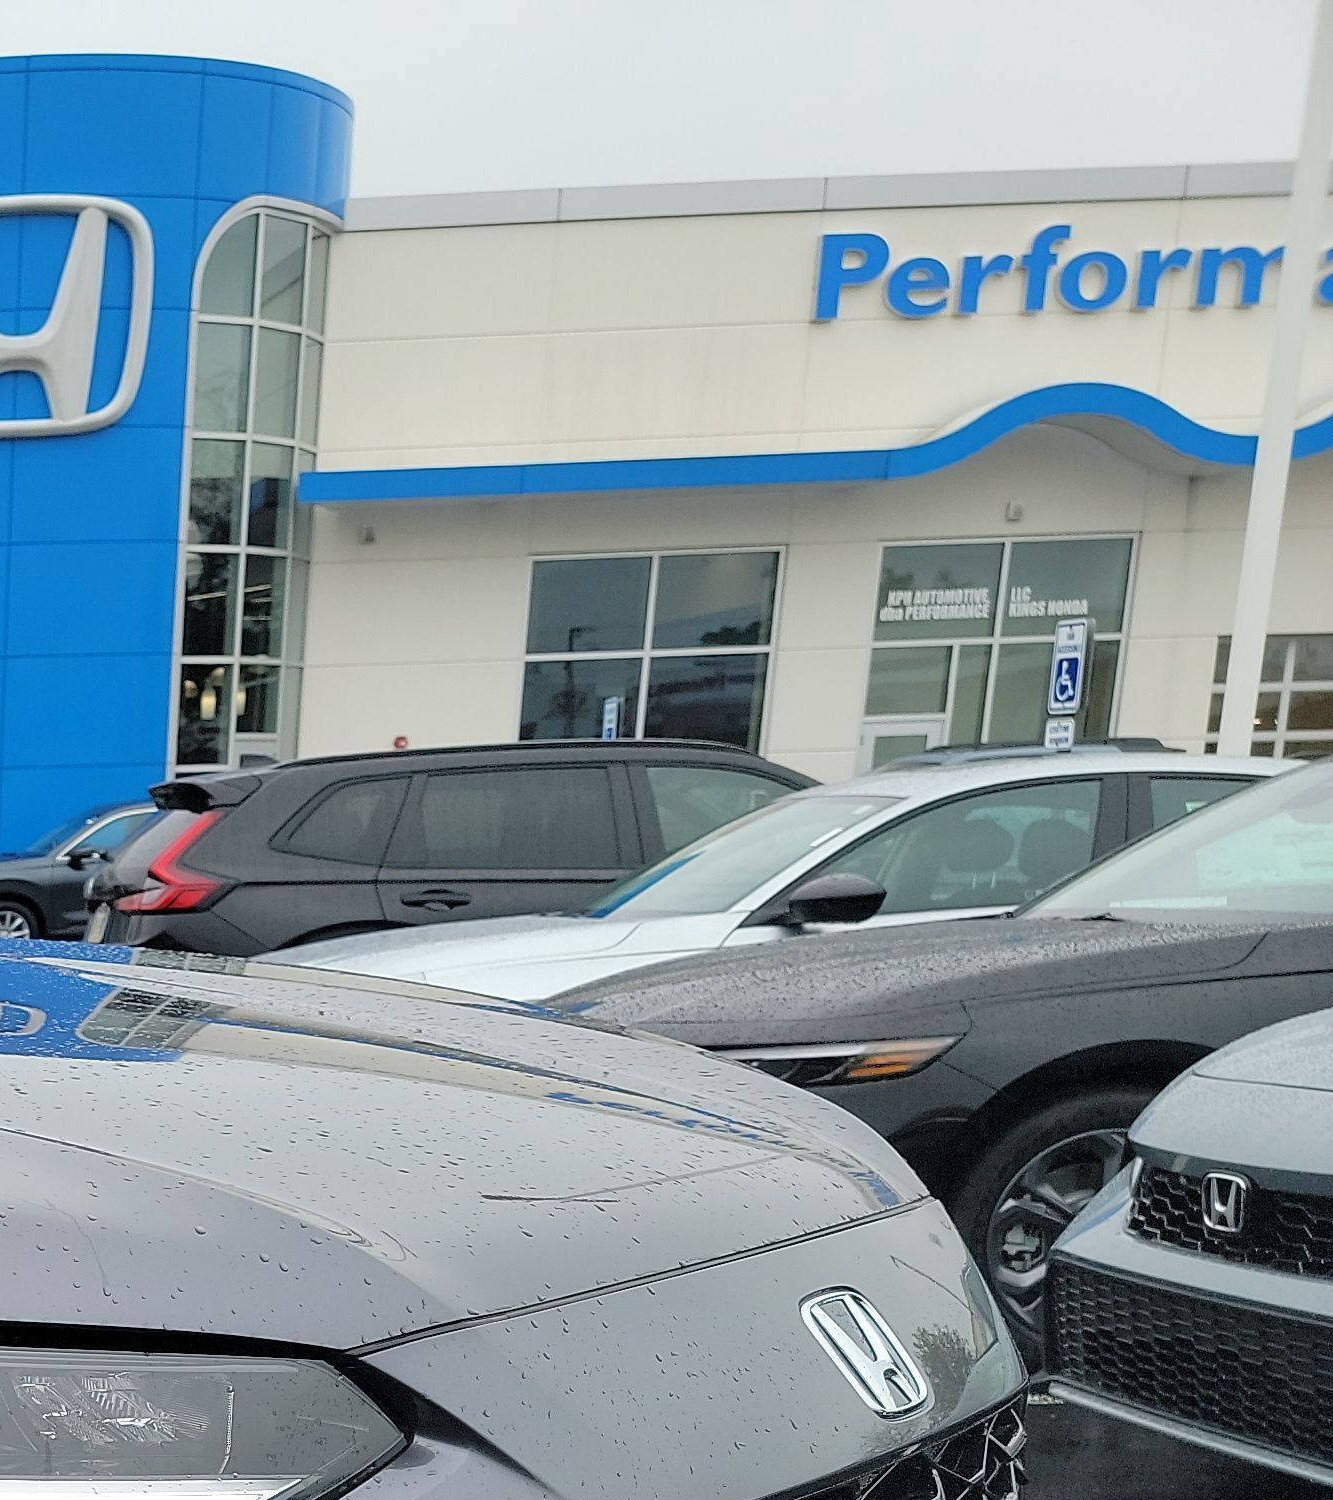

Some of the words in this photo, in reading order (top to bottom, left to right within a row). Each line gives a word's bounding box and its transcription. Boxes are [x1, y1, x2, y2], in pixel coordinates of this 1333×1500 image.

[813, 224, 1333, 322] Perform
[913, 587, 991, 606] AUTOMOTIVE
[1010, 586, 1032, 602] LLC
[904, 603, 990, 621] PERFORMANCE
[1008, 600, 1046, 618] KINGS
[1047, 598, 1089, 617] HONDA
